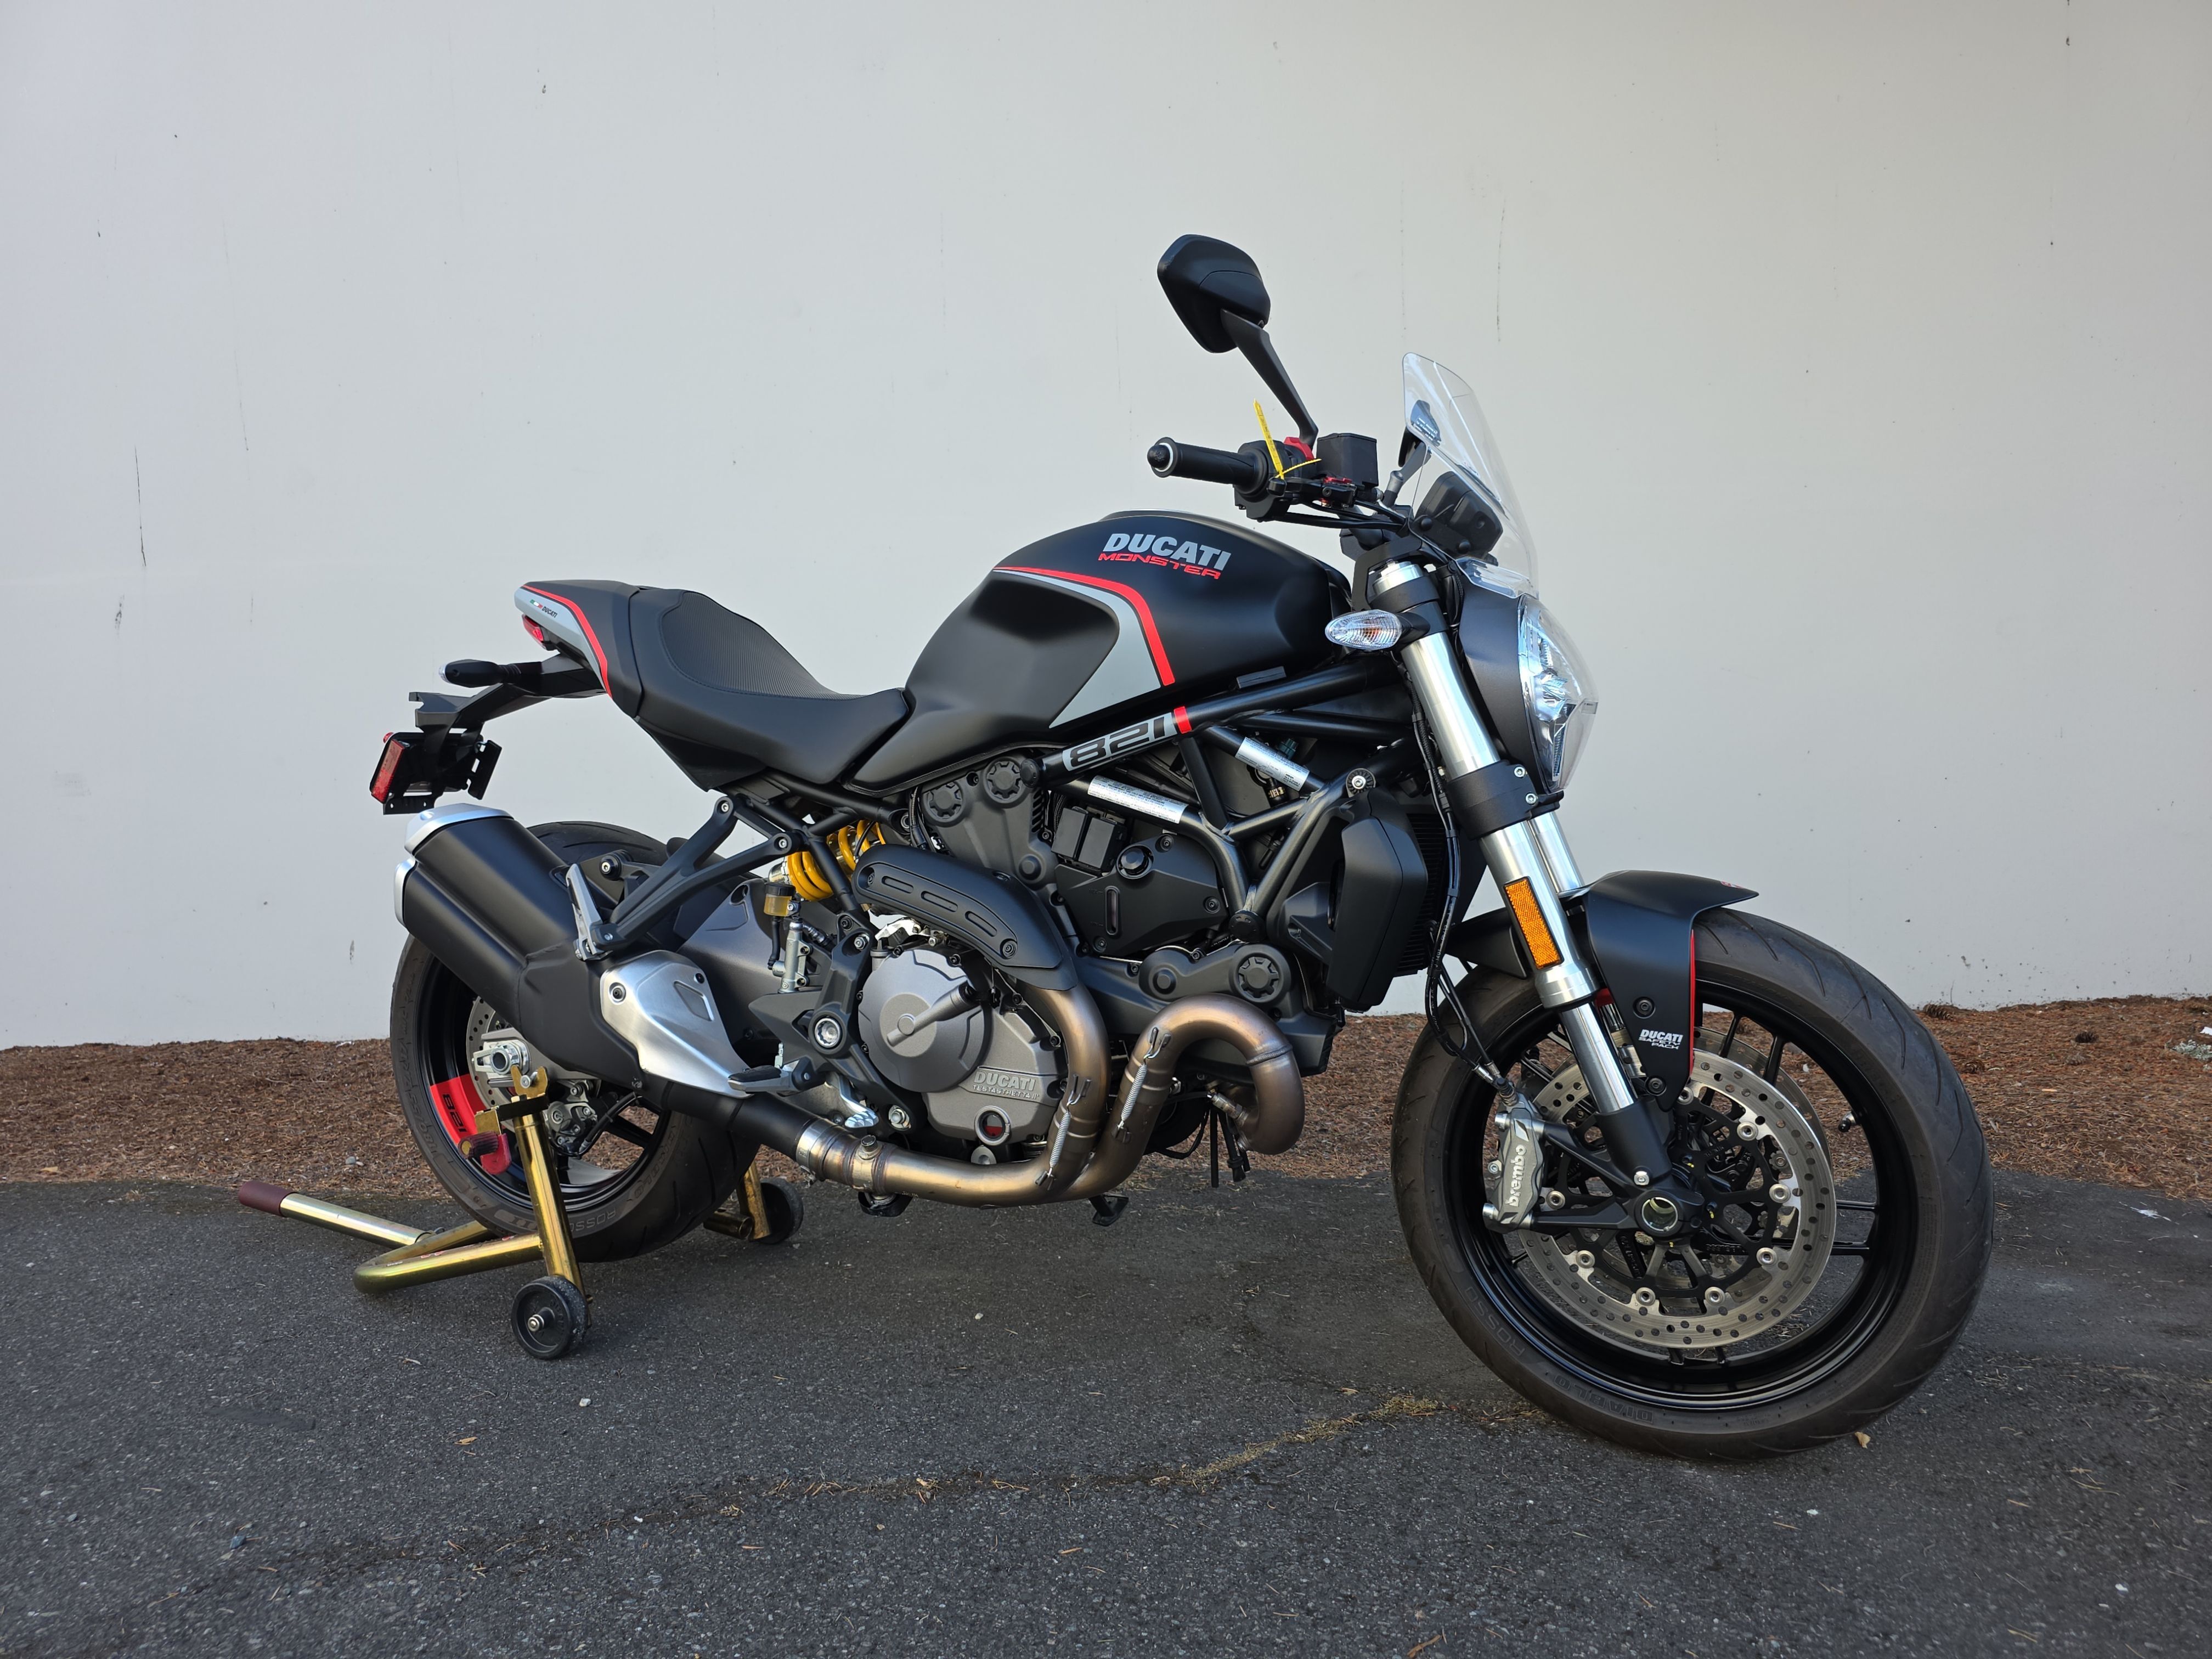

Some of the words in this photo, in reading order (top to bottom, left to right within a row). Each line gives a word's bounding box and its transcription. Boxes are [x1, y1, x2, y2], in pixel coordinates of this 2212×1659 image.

[1098, 552, 1221, 579] MONSTER
[1102, 533, 1232, 571] DUCATI
[541, 606, 557, 618] DUCATI
[1069, 716, 1165, 768] 821
[1638, 1037, 1680, 1045] SAFETY
[1640, 1029, 1684, 1042] DUCATI
[974, 1071, 1036, 1091] DUCATI
[442, 1094, 468, 1133] 821
[1504, 1144, 1526, 1207] brembo
[1464, 1285, 1525, 1356] ROSSO
[1553, 1374, 1655, 1425] DIABLO
